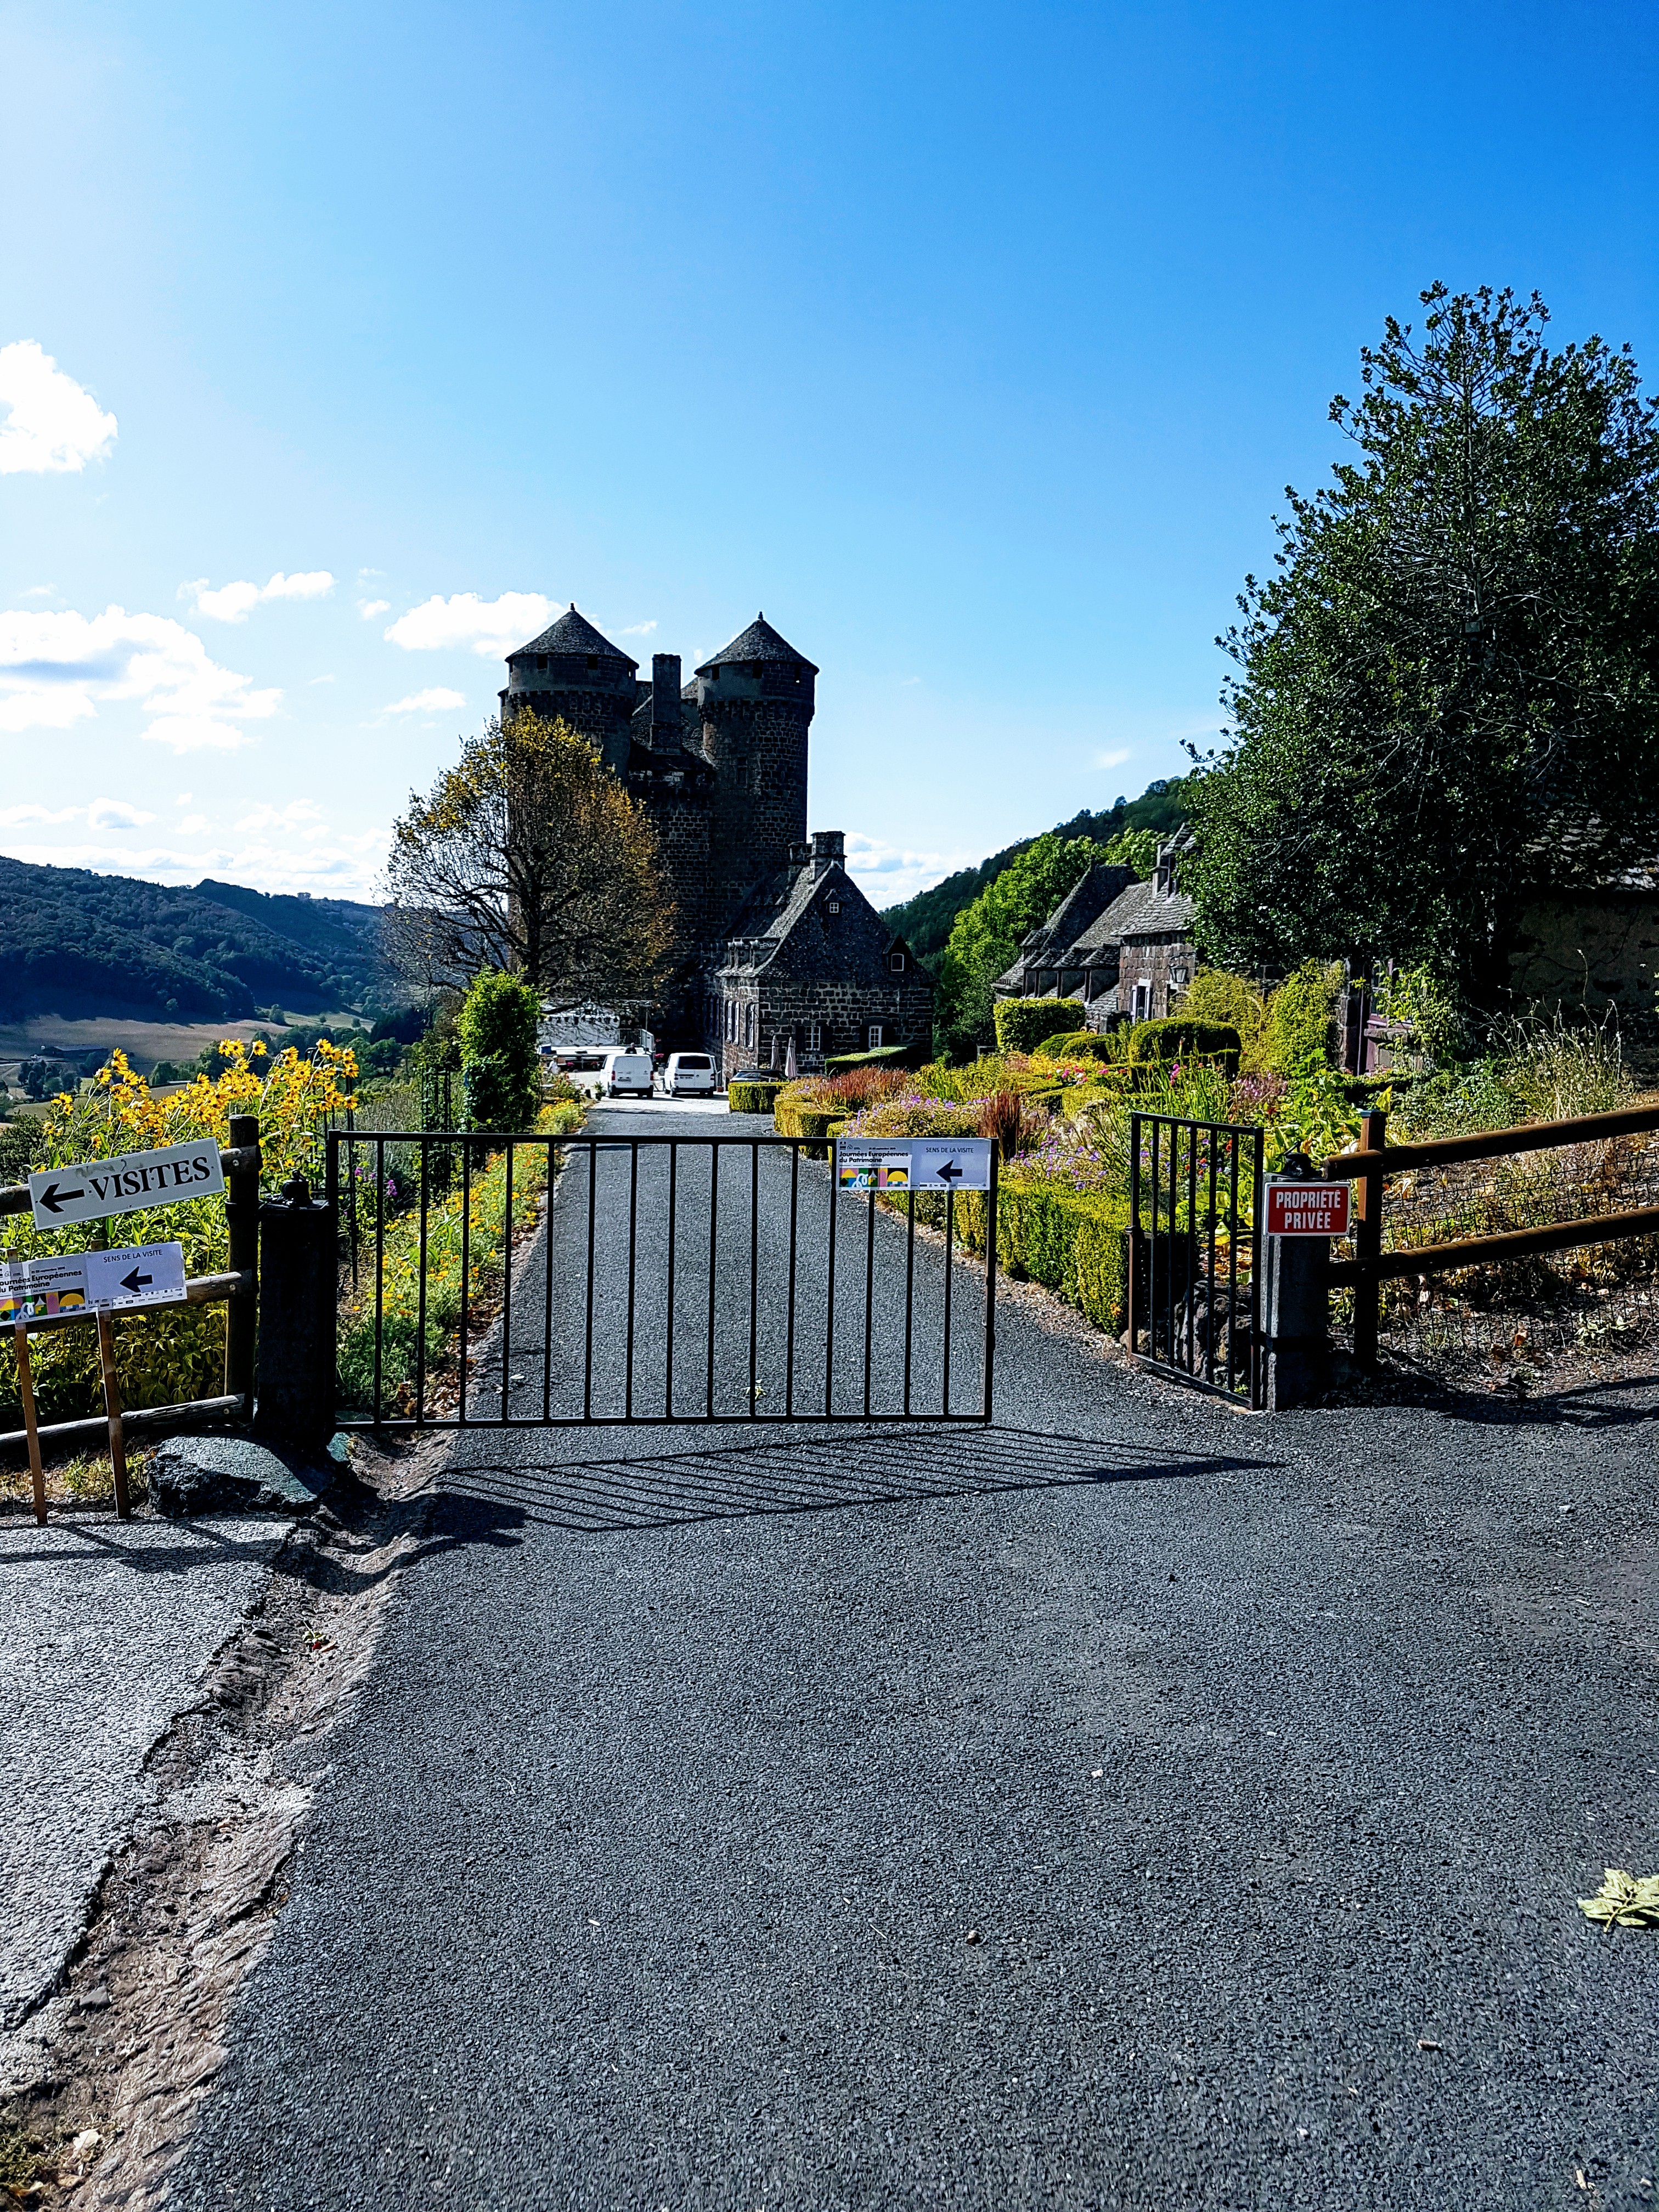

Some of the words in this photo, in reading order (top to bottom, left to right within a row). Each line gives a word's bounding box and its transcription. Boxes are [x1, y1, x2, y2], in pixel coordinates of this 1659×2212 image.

[88, 1156, 211, 1201] VISITES
[1276, 1189, 1341, 1209] PROPRIÉTÉ
[1284, 1210, 1331, 1229] PRIVÉE
[103, 1255, 121, 1263] SENS
[142, 1249, 163, 1257] VISITE
[0, 1277, 31, 1286] ournées
[31, 1270, 82, 1280] Européennes
[9, 1281, 50, 1291] Patrimoine
